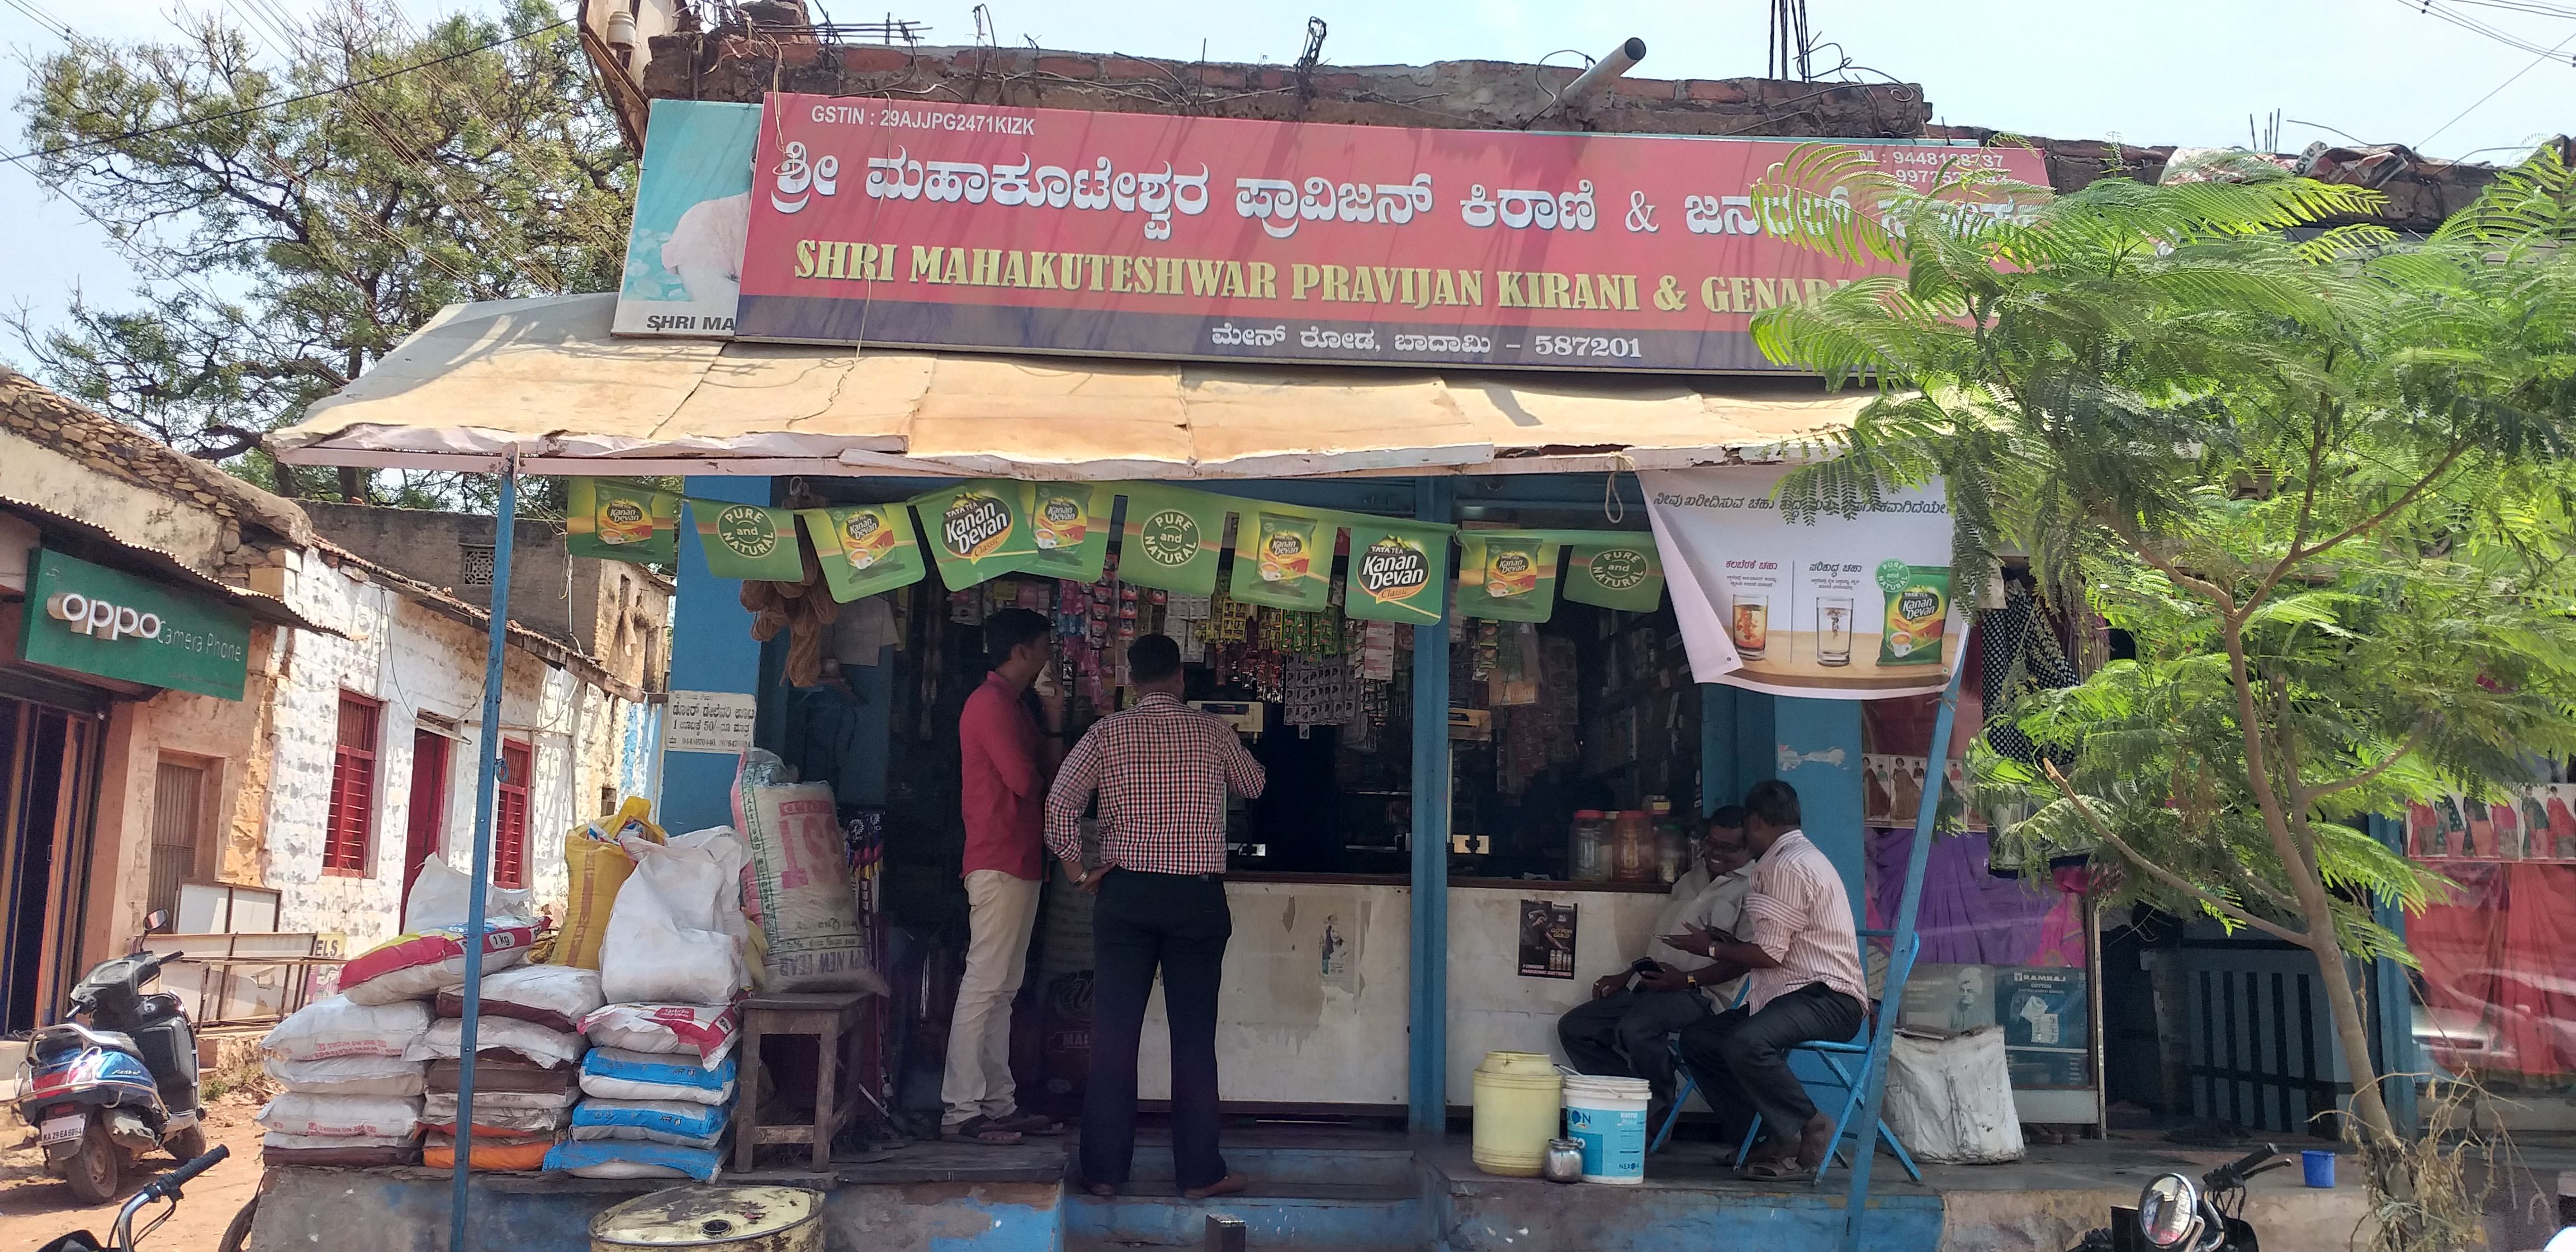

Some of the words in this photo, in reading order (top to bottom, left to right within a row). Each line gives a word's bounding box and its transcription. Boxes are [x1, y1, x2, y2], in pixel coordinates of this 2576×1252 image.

[811, 105, 865, 126] GSTIN
[771, 141, 839, 214] ಶ್ರೀ
[865, 144, 1210, 240] ಮಹಾಕೂಟೇಶ್ವರ
[1234, 173, 1434, 239] ಪ್ರಾವಿಜನ್
[1459, 179, 1597, 231] ಕಿರಾಣಿ
[1624, 190, 1660, 233] &
[794, 239, 898, 282] SHRI
[908, 245, 1278, 299] MAHAKUTESHWAR
[1291, 263, 1484, 309] PRAVIJAN
[1497, 271, 1640, 311] KIRANI
[1653, 274, 1687, 312] &
[646, 315, 696, 332] SHRI
[1211, 324, 1287, 349] ಮೇನ್
[1394, 329, 1491, 354] ಬಾದಾಮಿ
[1534, 335, 1642, 359] 587201
[610, 509, 636, 517] Kanan
[724, 508, 764, 524] PURE
[945, 507, 966, 518] TATA
[1048, 505, 1073, 515] Kanan
[1049, 512, 1076, 521] Devan
[849, 518, 873, 535] Kanan
[945, 502, 996, 543] Kanan
[1154, 514, 1193, 532] PURE
[736, 527, 759, 535] and
[855, 523, 877, 539] Devan
[958, 513, 1008, 554] Devan
[1159, 533, 1182, 543] and
[722, 532, 774, 556] NATURAL
[974, 535, 1000, 557] Classic
[1145, 535, 1197, 564] NATURAL
[1272, 540, 1296, 549] Kanan
[1274, 547, 1299, 556] Devan
[1362, 554, 1418, 576] Kanan
[1499, 559, 1523, 568] Kanan
[1603, 551, 1641, 563] PURE
[1501, 565, 1526, 574] Devan
[1882, 562, 1904, 570] PURE
[1369, 568, 1424, 590] Devan
[1593, 566, 1645, 587] NATURAL
[1878, 575, 1908, 591] NATURAL
[1381, 587, 1409, 599] Classic
[1902, 597, 1933, 612] Kanan
[1906, 605, 1935, 620] Devan
[206, 633, 242, 662] Phone
[498, 933, 509, 947] kg
